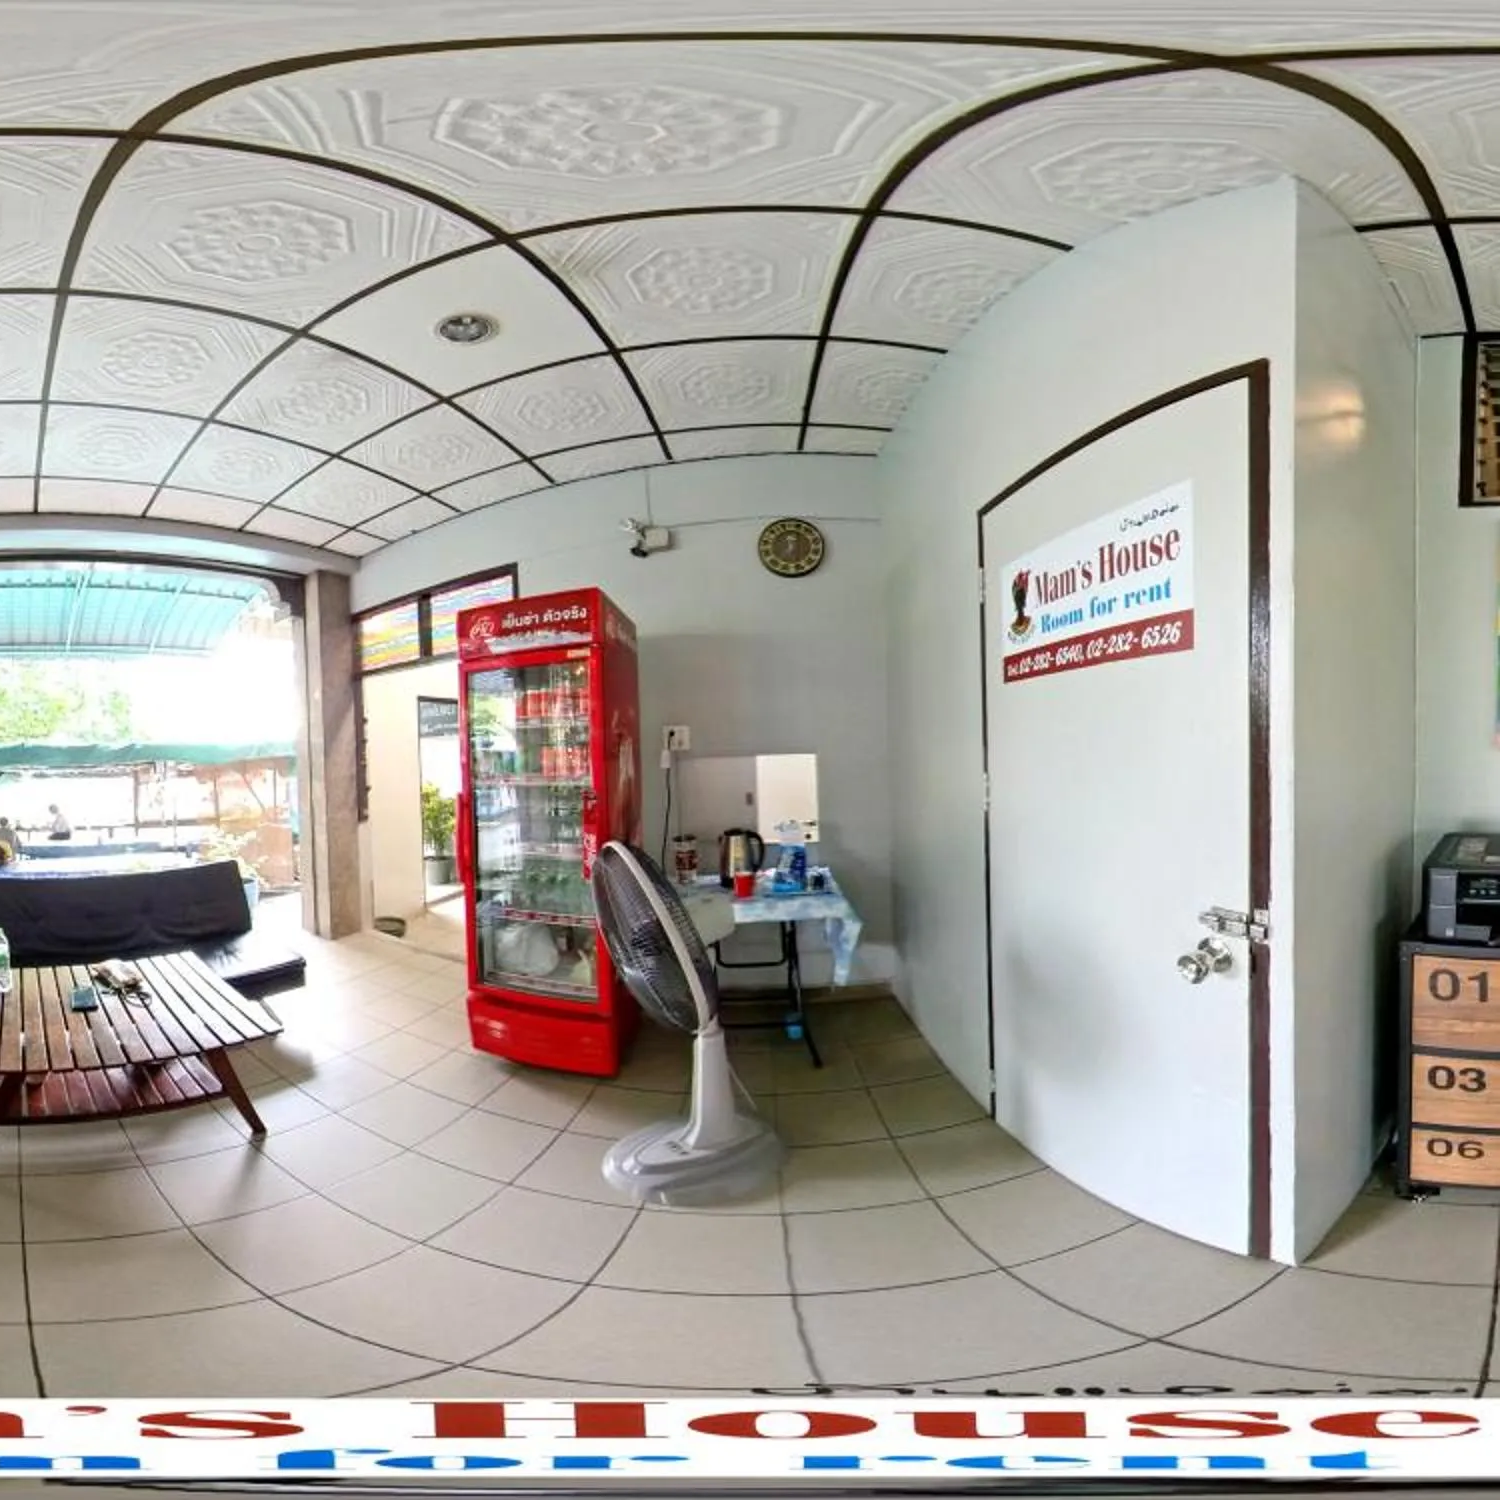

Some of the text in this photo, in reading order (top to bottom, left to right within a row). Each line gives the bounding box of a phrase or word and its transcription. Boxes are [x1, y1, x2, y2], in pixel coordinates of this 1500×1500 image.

[1035, 528, 1181, 608] Mam's House
[1041, 576, 1173, 634] Room for rent
[1428, 968, 1489, 1003] 01
[1427, 1065, 1487, 1093] 03
[1426, 1138, 1485, 1160] 06
